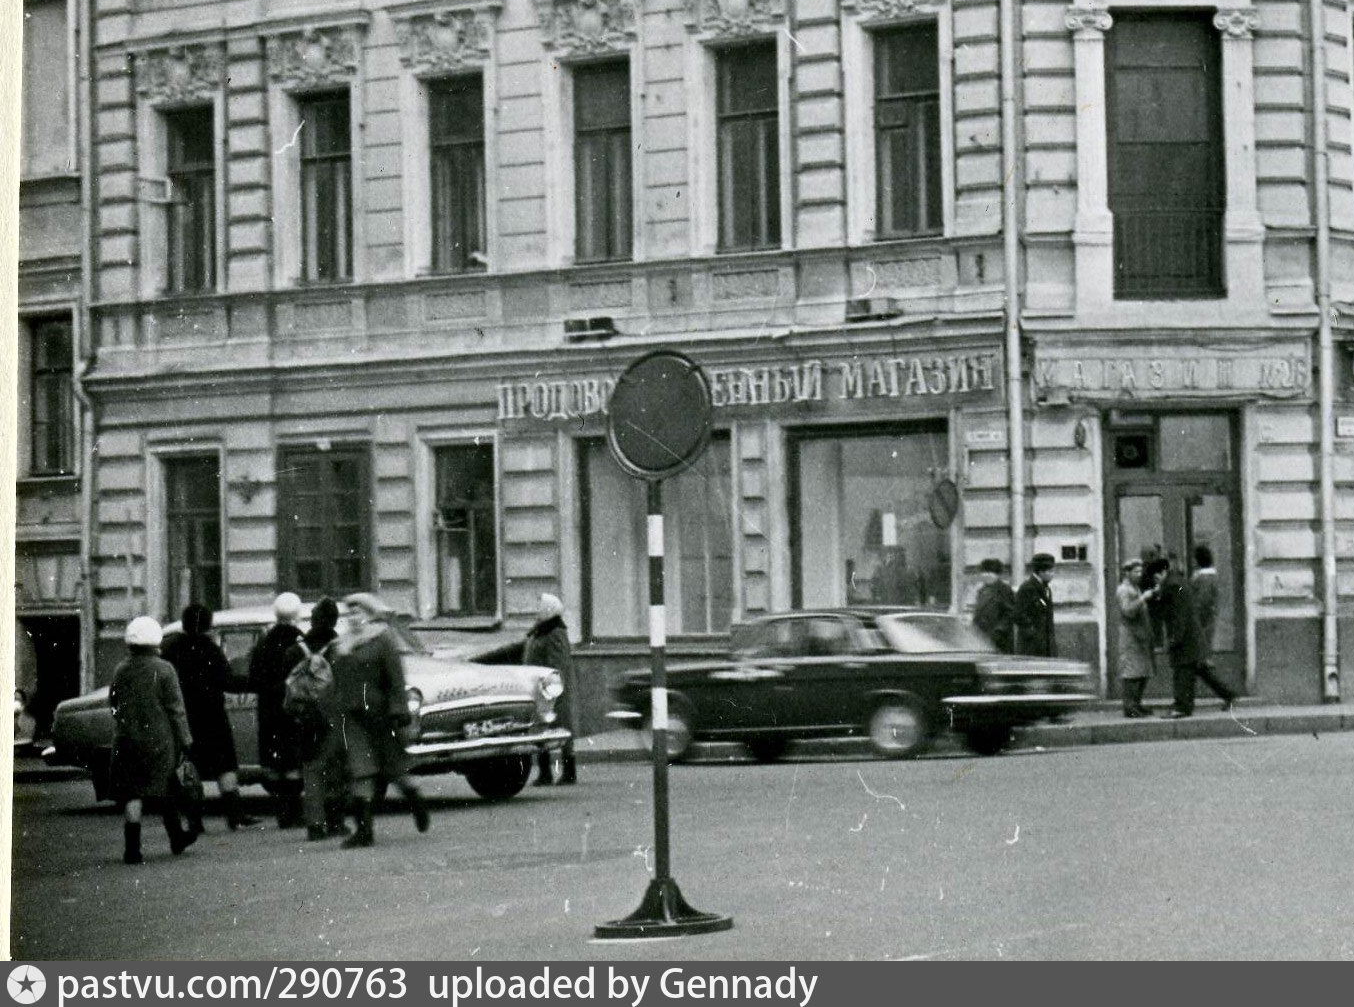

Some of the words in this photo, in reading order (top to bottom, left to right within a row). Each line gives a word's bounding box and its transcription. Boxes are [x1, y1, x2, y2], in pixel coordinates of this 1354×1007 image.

[496, 359, 822, 421] ПРОДОВОЕННЫЙ
[838, 354, 994, 400] МАГАЗИН
[1033, 358, 1234, 391] МАГАЗИН
